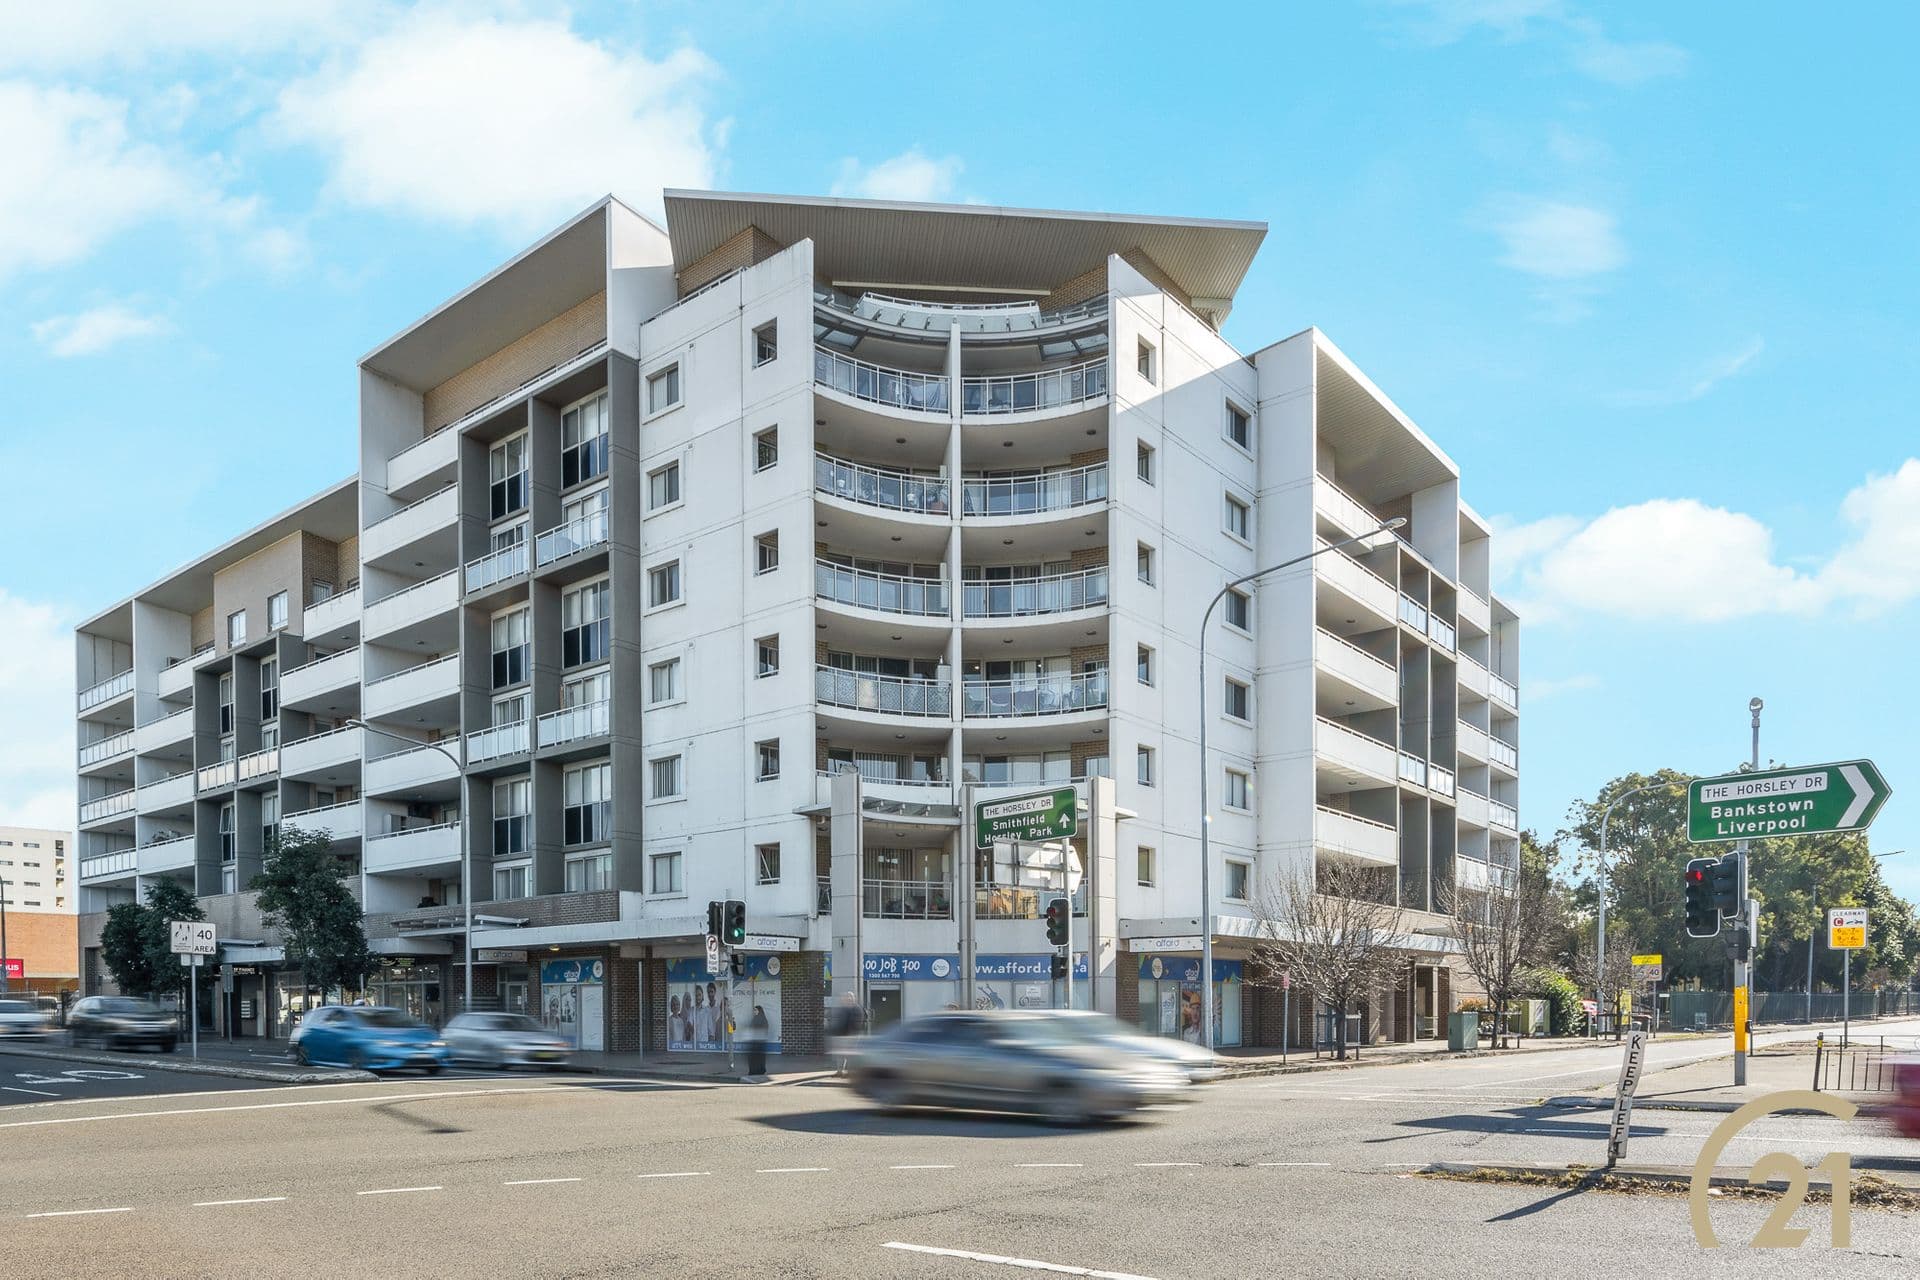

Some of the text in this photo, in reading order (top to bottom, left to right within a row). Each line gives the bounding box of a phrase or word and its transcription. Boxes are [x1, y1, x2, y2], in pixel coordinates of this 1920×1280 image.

[1705, 776, 1823, 799] THE HORSLEY DR
[985, 798, 1051, 816] THE HORSLEY DR
[1711, 799, 1814, 819] Bankstown
[992, 814, 1045, 831] Smithfield
[1718, 815, 1806, 835] Liverpool
[1029, 826, 1053, 838] Park
[197, 930, 212, 940] 40
[194, 945, 215, 953] AREA
[878, 957, 897, 973] JOB
[902, 959, 921, 973] 700
[1613, 1035, 1642, 1155] KEEP LEFT
